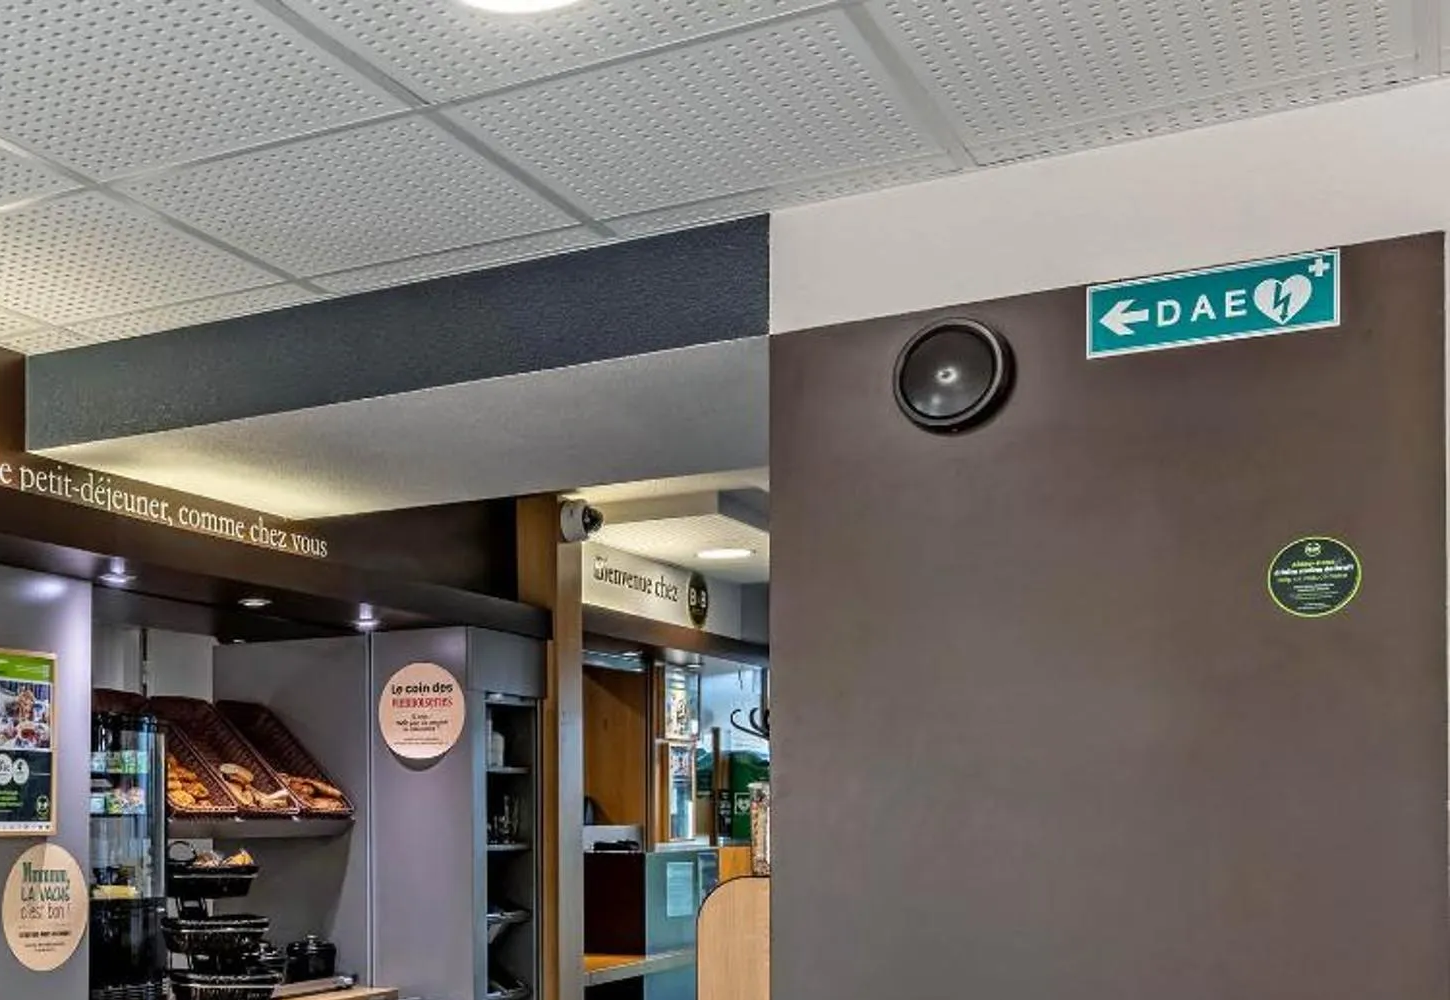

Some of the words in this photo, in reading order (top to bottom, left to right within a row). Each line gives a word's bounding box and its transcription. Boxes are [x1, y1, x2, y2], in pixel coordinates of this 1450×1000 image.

[1157, 289, 1247, 328] DAE
[19, 465, 174, 526] petit-déjeuner,
[179, 506, 245, 540] comme
[250, 516, 287, 549] chez
[291, 533, 329, 558] vous
[593, 555, 653, 594] Bienvenue
[655, 575, 678, 602] chez
[391, 684, 403, 695] Le
[405, 682, 430, 694] coin
[432, 682, 453, 693] des
